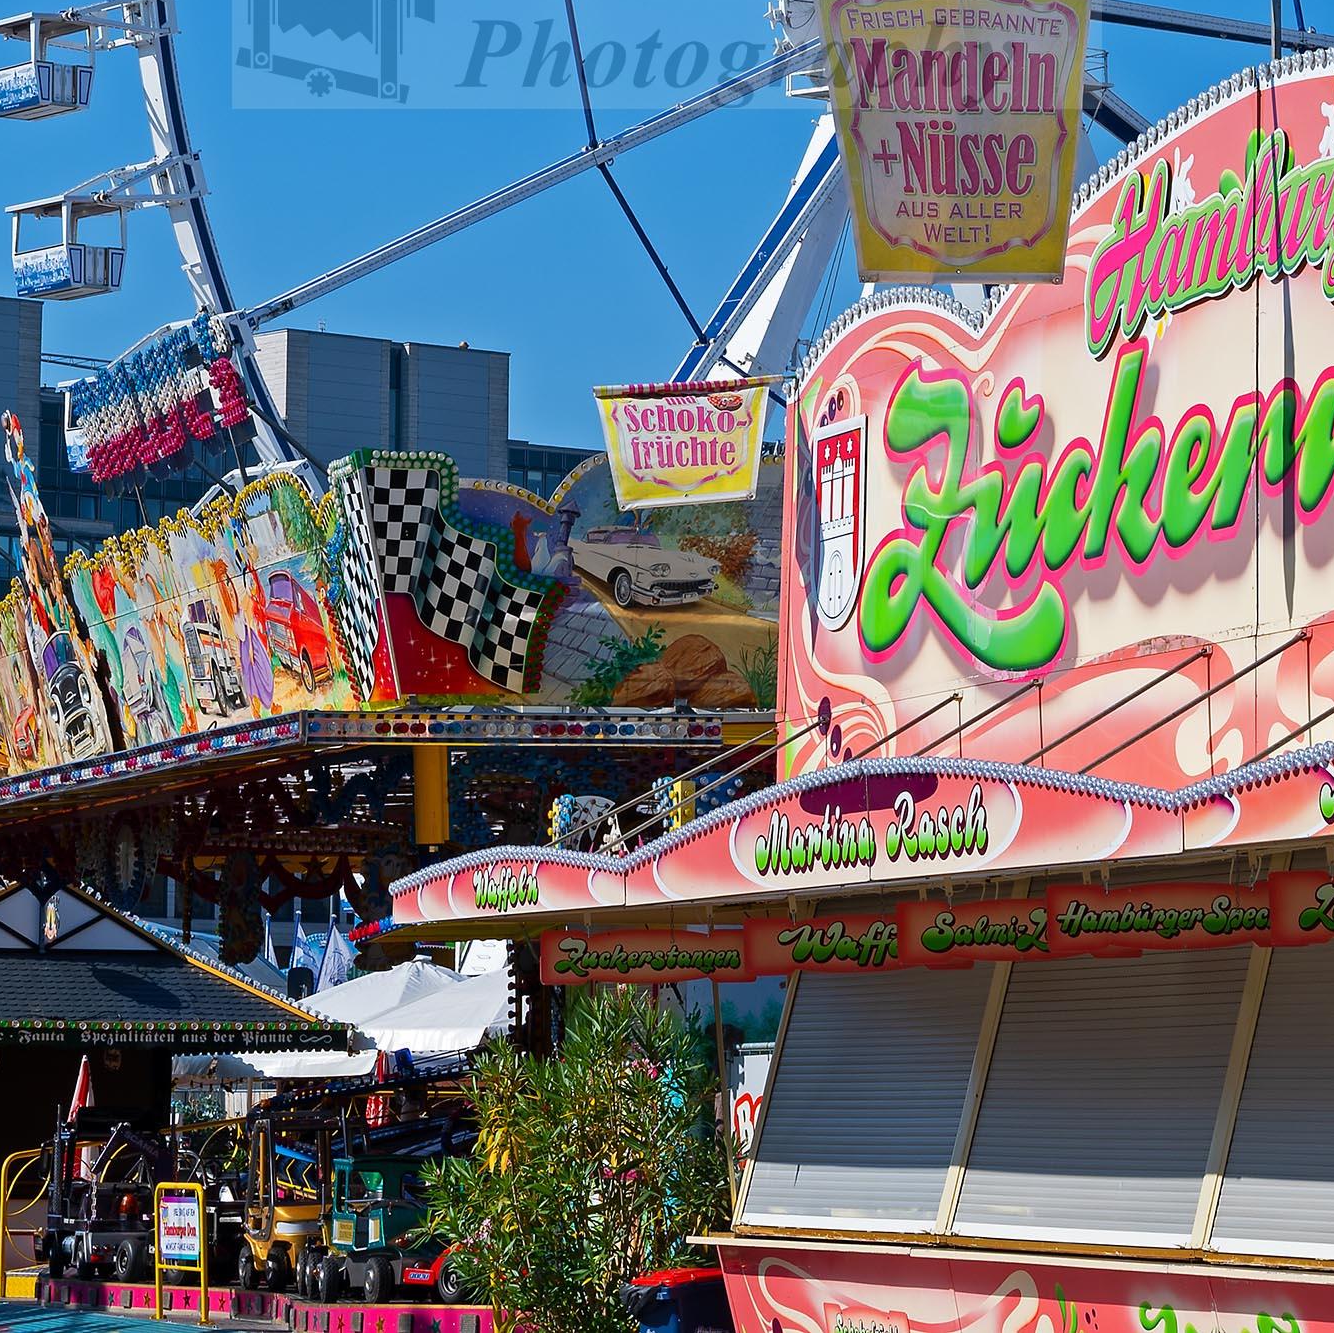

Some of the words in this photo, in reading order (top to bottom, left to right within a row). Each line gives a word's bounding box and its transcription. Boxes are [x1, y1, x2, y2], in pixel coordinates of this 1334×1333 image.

[845, 8, 927, 31] FRISCH
[935, 9, 1062, 38] GEBRANNTE
[849, 36, 1056, 113] Mandeln
[896, 202, 939, 219] AUS
[949, 202, 1023, 220] ALLER
[924, 222, 992, 244] WELT!
[623, 402, 748, 434] Schoko-
[630, 435, 737, 471] früchte
[754, 810, 875, 877] Martina
[885, 783, 989, 863] Rasch
[473, 866, 539, 912] Waffeln
[920, 907, 1051, 953] Salmi-L
[1056, 900, 1202, 938] Hamburger
[553, 936, 743, 977] Zuckerstangen
[18, 1029, 65, 1045] Fanta
[80, 1030, 175, 1046] Spezialitäten
[181, 1032, 208, 1043] aus
[213, 1031, 235, 1043] der
[241, 1031, 294, 1046] Pfanne
